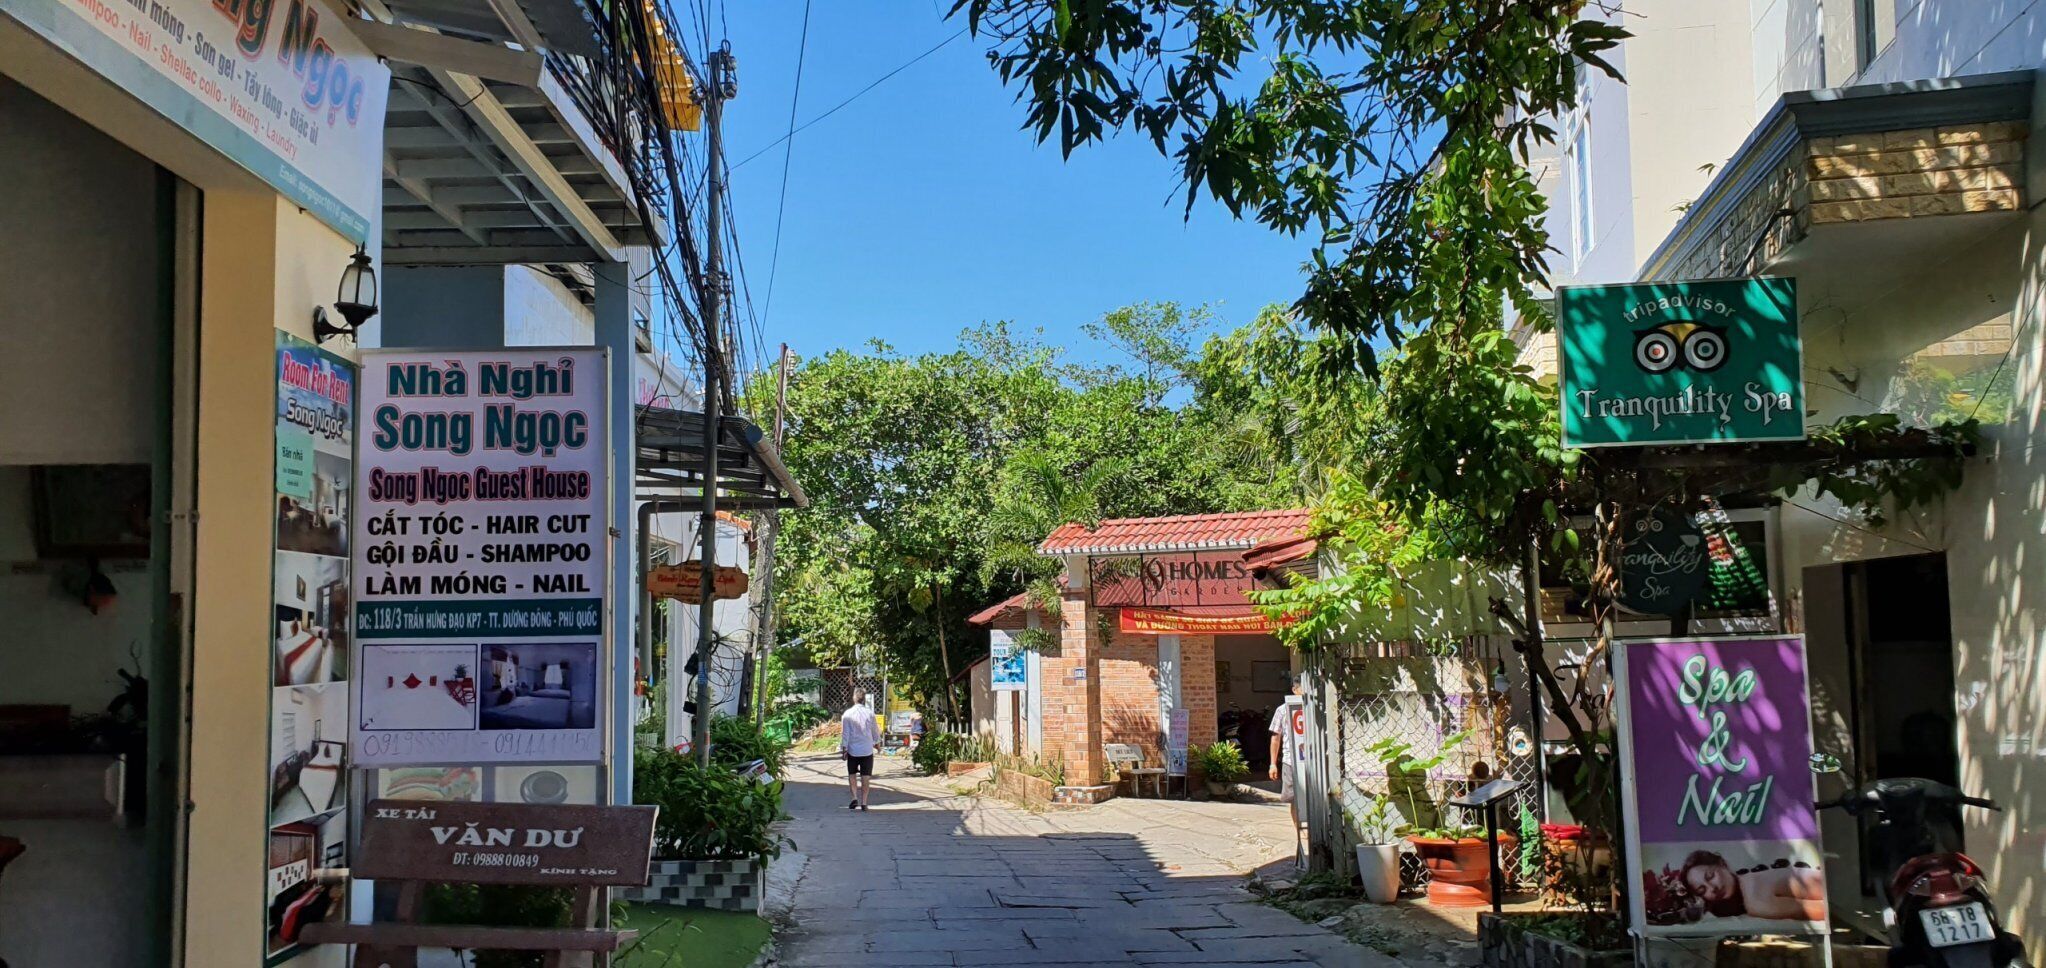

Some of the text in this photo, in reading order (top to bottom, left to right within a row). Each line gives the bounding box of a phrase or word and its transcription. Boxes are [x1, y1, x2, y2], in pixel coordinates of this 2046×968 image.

[150, 0, 184, 44] móng
[195, 32, 216, 68] Sơn
[218, 53, 236, 80] gel
[277, 0, 365, 127] Ngọc
[129, 20, 152, 51] Nail
[161, 44, 198, 85] Shellac
[200, 76, 221, 102] collo
[230, 94, 260, 133] Waxing
[266, 122, 297, 160] Laundry
[1623, 293, 1737, 324] tripadvisor
[282, 350, 350, 405] Room For Rent
[386, 356, 574, 400] Nhà Nghỉ
[286, 397, 343, 439] Song Ngọc
[1576, 381, 1793, 433] Tranquility Spa
[372, 402, 589, 457] Song Ngọc
[369, 465, 591, 506] Song Ngoc Guest House
[367, 508, 411, 535] CẮT
[418, 511, 464, 535] TÓC
[486, 515, 539, 534] HAIR
[547, 514, 591, 533] CUT
[367, 540, 404, 568] GỘI
[412, 537, 458, 563] ĐẦU
[481, 543, 591, 563] SHAMPOO
[366, 571, 421, 595] LÀM
[431, 570, 507, 594] MÓNG
[533, 574, 590, 593] NAIL
[1640, 577, 1671, 600] Spa
[374, 607, 401, 630] 118/3
[449, 613, 464, 632] ĐẠO
[466, 612, 482, 629] KP7
[558, 606, 574, 627] PHÚ
[576, 604, 597, 629] QUỐC
[1679, 654, 1756, 719] Spa
[1698, 710, 1747, 773] &
[375, 808, 400, 819] XE
[1677, 774, 1774, 827] Nail
[430, 822, 584, 848] VĂN DƯ
[453, 852, 471, 866] ĐT:
[1937, 923, 1980, 942] 1217
